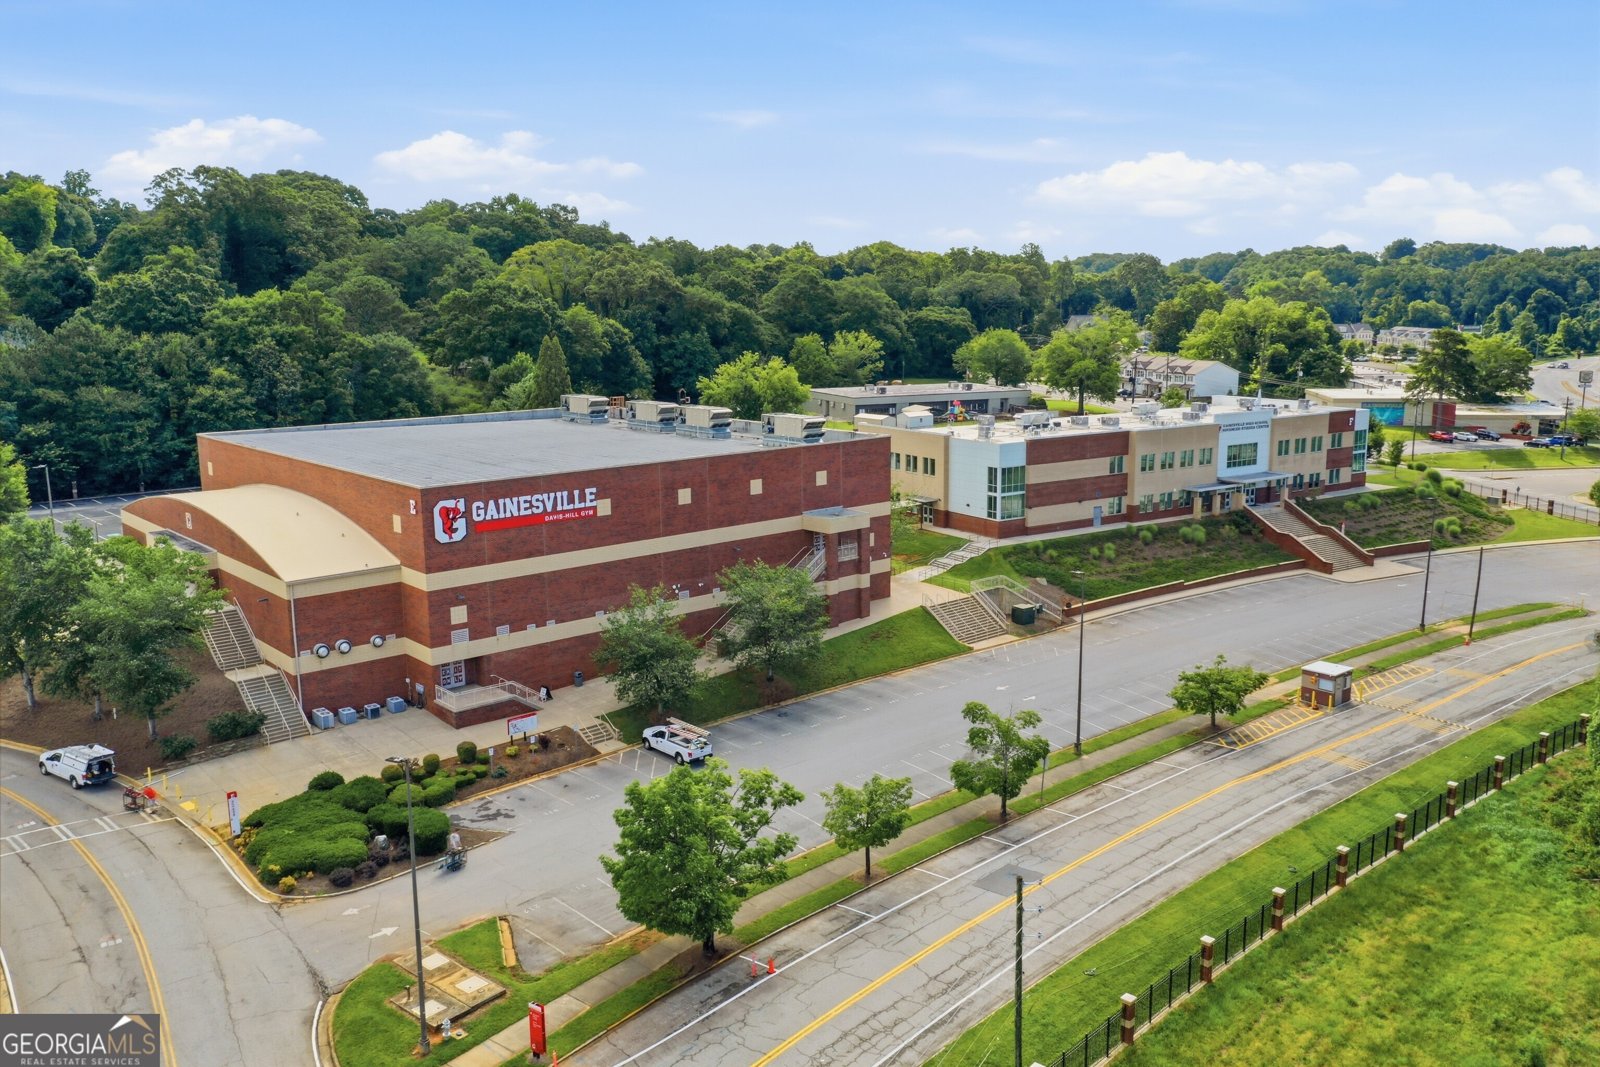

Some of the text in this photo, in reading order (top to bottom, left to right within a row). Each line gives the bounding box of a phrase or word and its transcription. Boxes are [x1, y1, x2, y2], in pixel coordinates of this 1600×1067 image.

[409, 499, 417, 515] E
[472, 487, 597, 522] GAINESVILLE
[544, 509, 594, 522] DAVIS-HILL GYM
